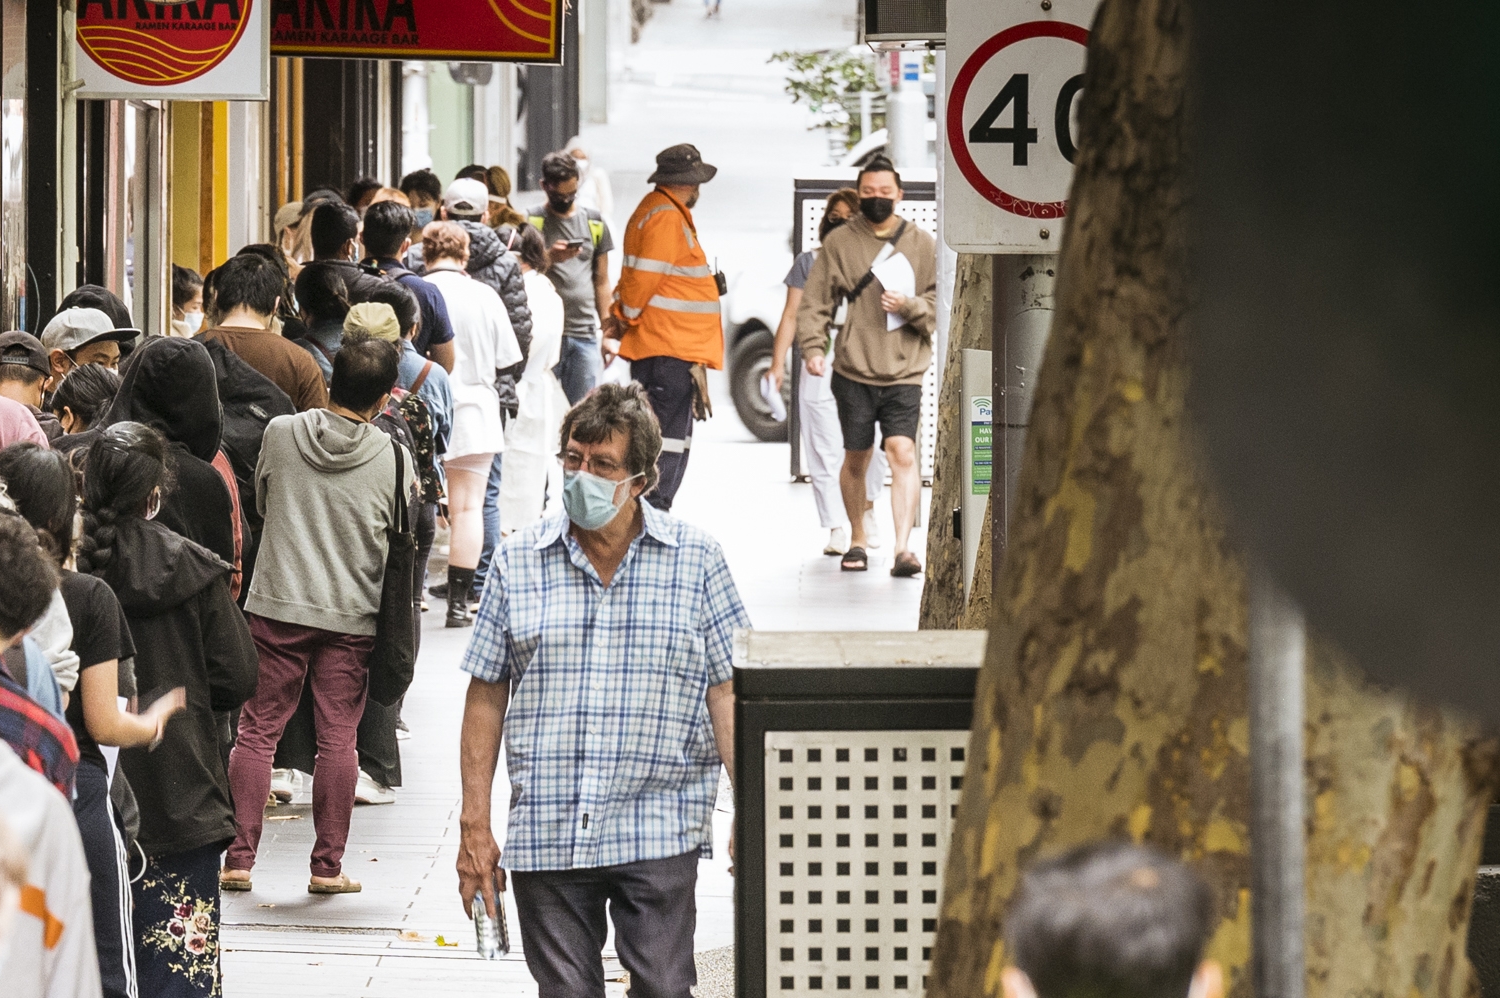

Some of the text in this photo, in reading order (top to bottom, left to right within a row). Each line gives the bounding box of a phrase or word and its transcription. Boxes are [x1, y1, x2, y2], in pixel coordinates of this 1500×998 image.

[136, 22, 237, 31] RAMEN KARAAGE BAR
[272, 30, 419, 45] AMEN KARAAGE BAR
[980, 408, 992, 417] Pa
